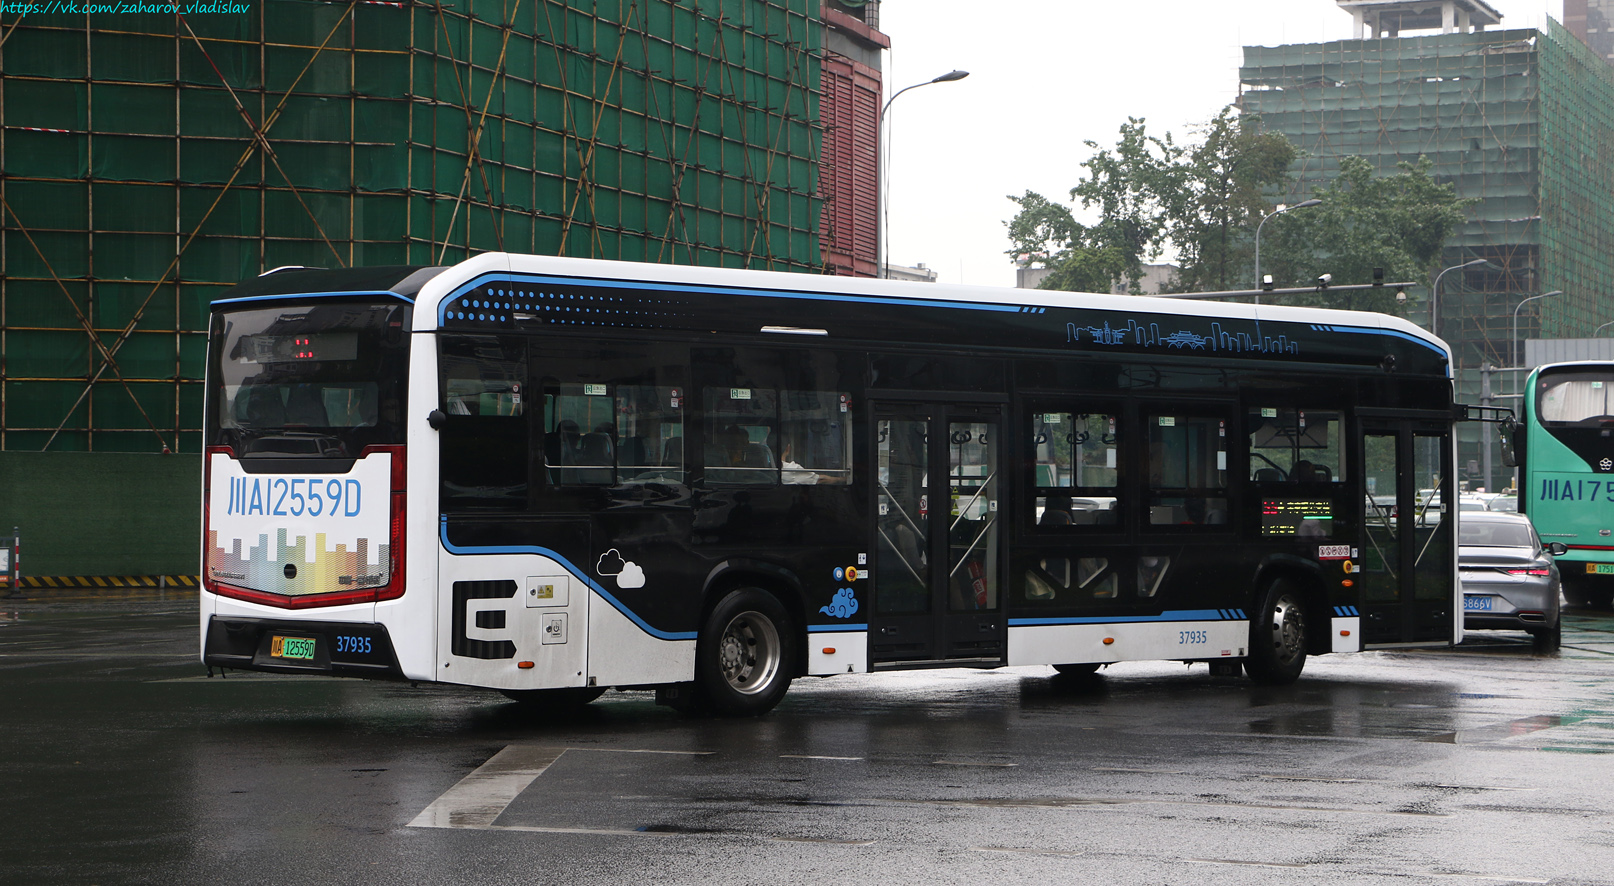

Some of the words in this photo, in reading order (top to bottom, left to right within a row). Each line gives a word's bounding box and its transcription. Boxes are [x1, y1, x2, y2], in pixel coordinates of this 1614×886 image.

[227, 476, 361, 517] 川A12559D
[336, 635, 372, 654] 37935
[1178, 630, 1208, 645] 37935
